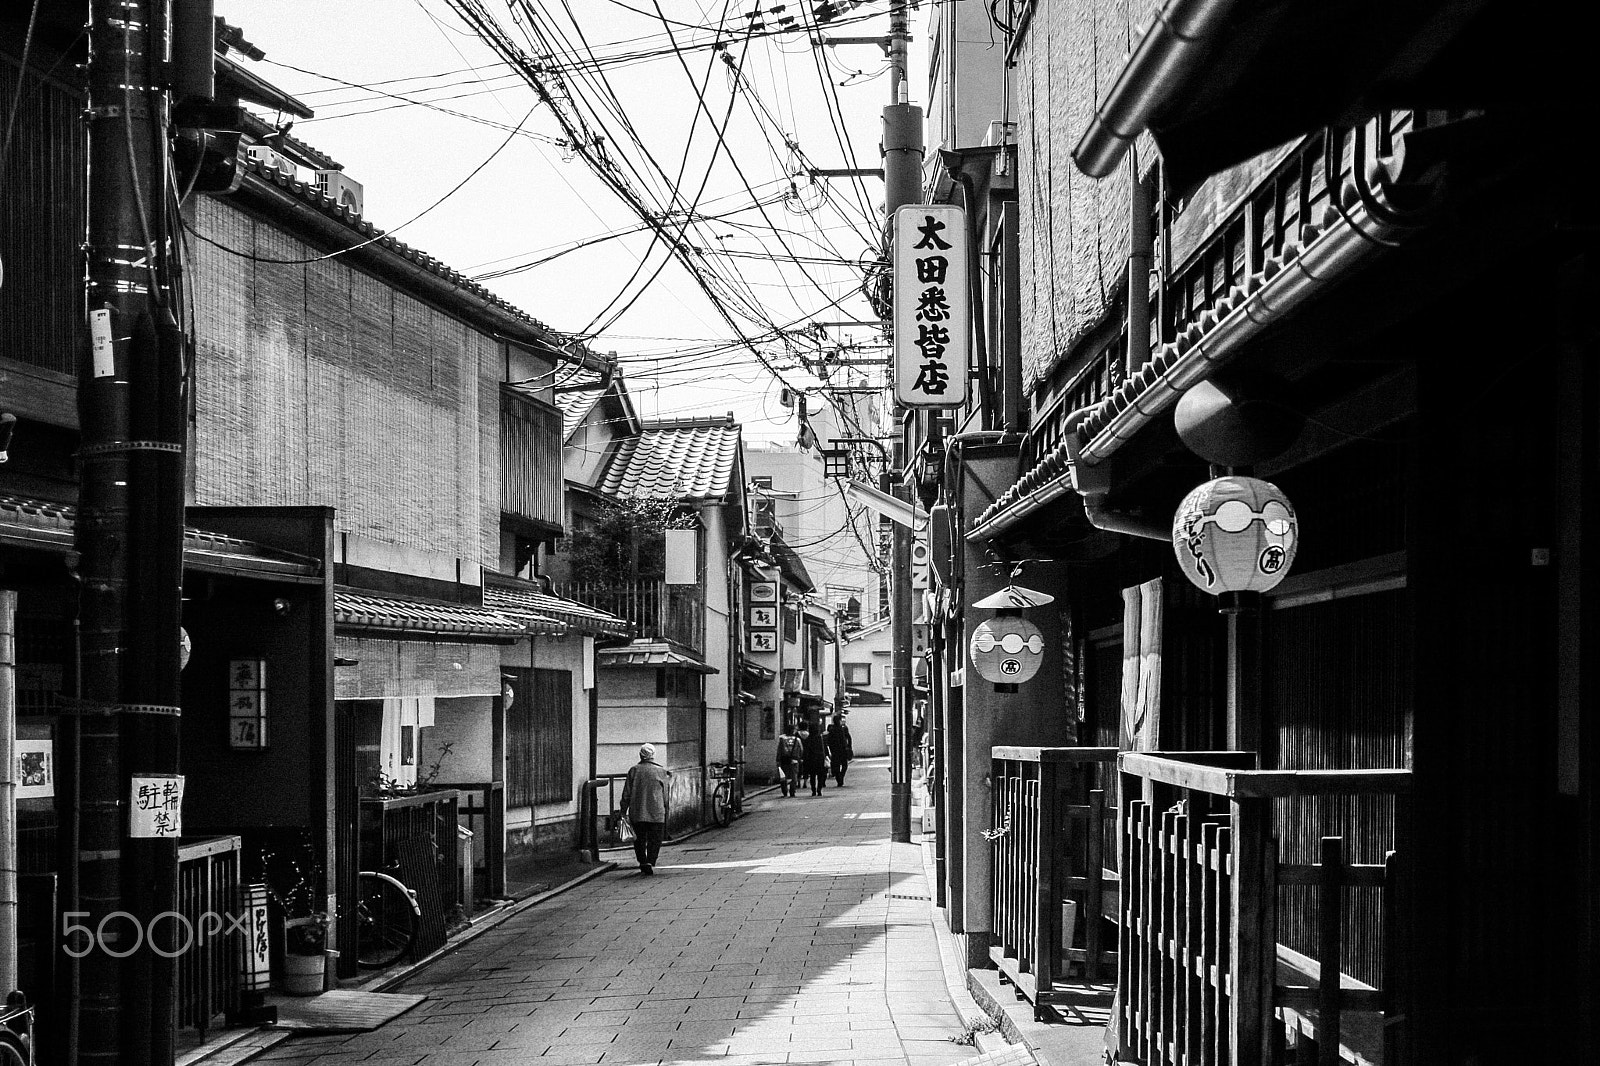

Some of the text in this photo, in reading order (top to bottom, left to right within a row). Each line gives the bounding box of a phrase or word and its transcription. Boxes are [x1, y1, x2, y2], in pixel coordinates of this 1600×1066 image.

[912, 215, 953, 396] 太田悉皆店
